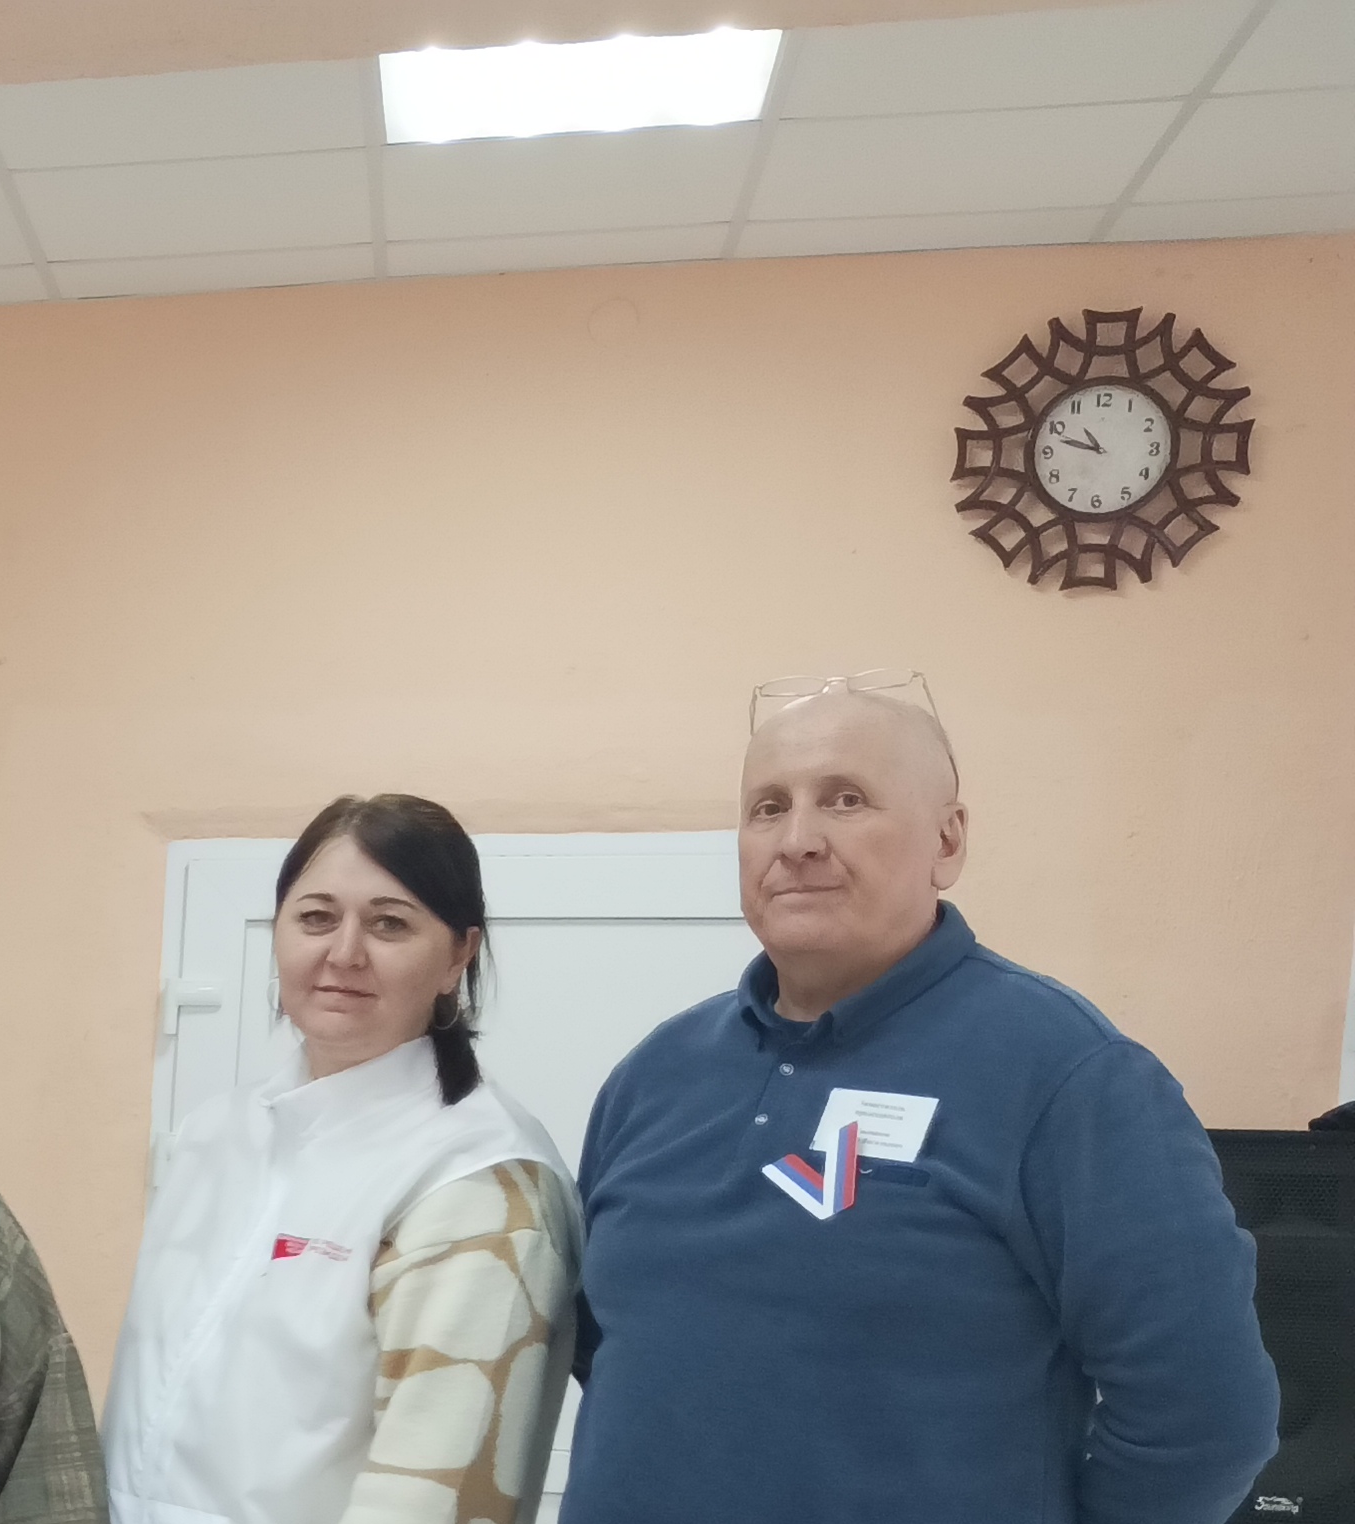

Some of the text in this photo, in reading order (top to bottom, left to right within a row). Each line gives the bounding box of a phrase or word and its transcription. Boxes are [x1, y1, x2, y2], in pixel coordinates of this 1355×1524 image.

[1071, 400, 1081, 414] 11
[1096, 393, 1112, 407] 12
[1049, 420, 1065, 435] 10
[1143, 418, 1154, 432] 2
[1042, 445, 1053, 459] 9
[1149, 441, 1160, 456] 3
[1048, 469, 1059, 484] 8
[1139, 467, 1149, 480] 4
[1068, 488, 1078, 502] 7
[1120, 486, 1132, 501] 5
[1091, 494, 1102, 509] 6
